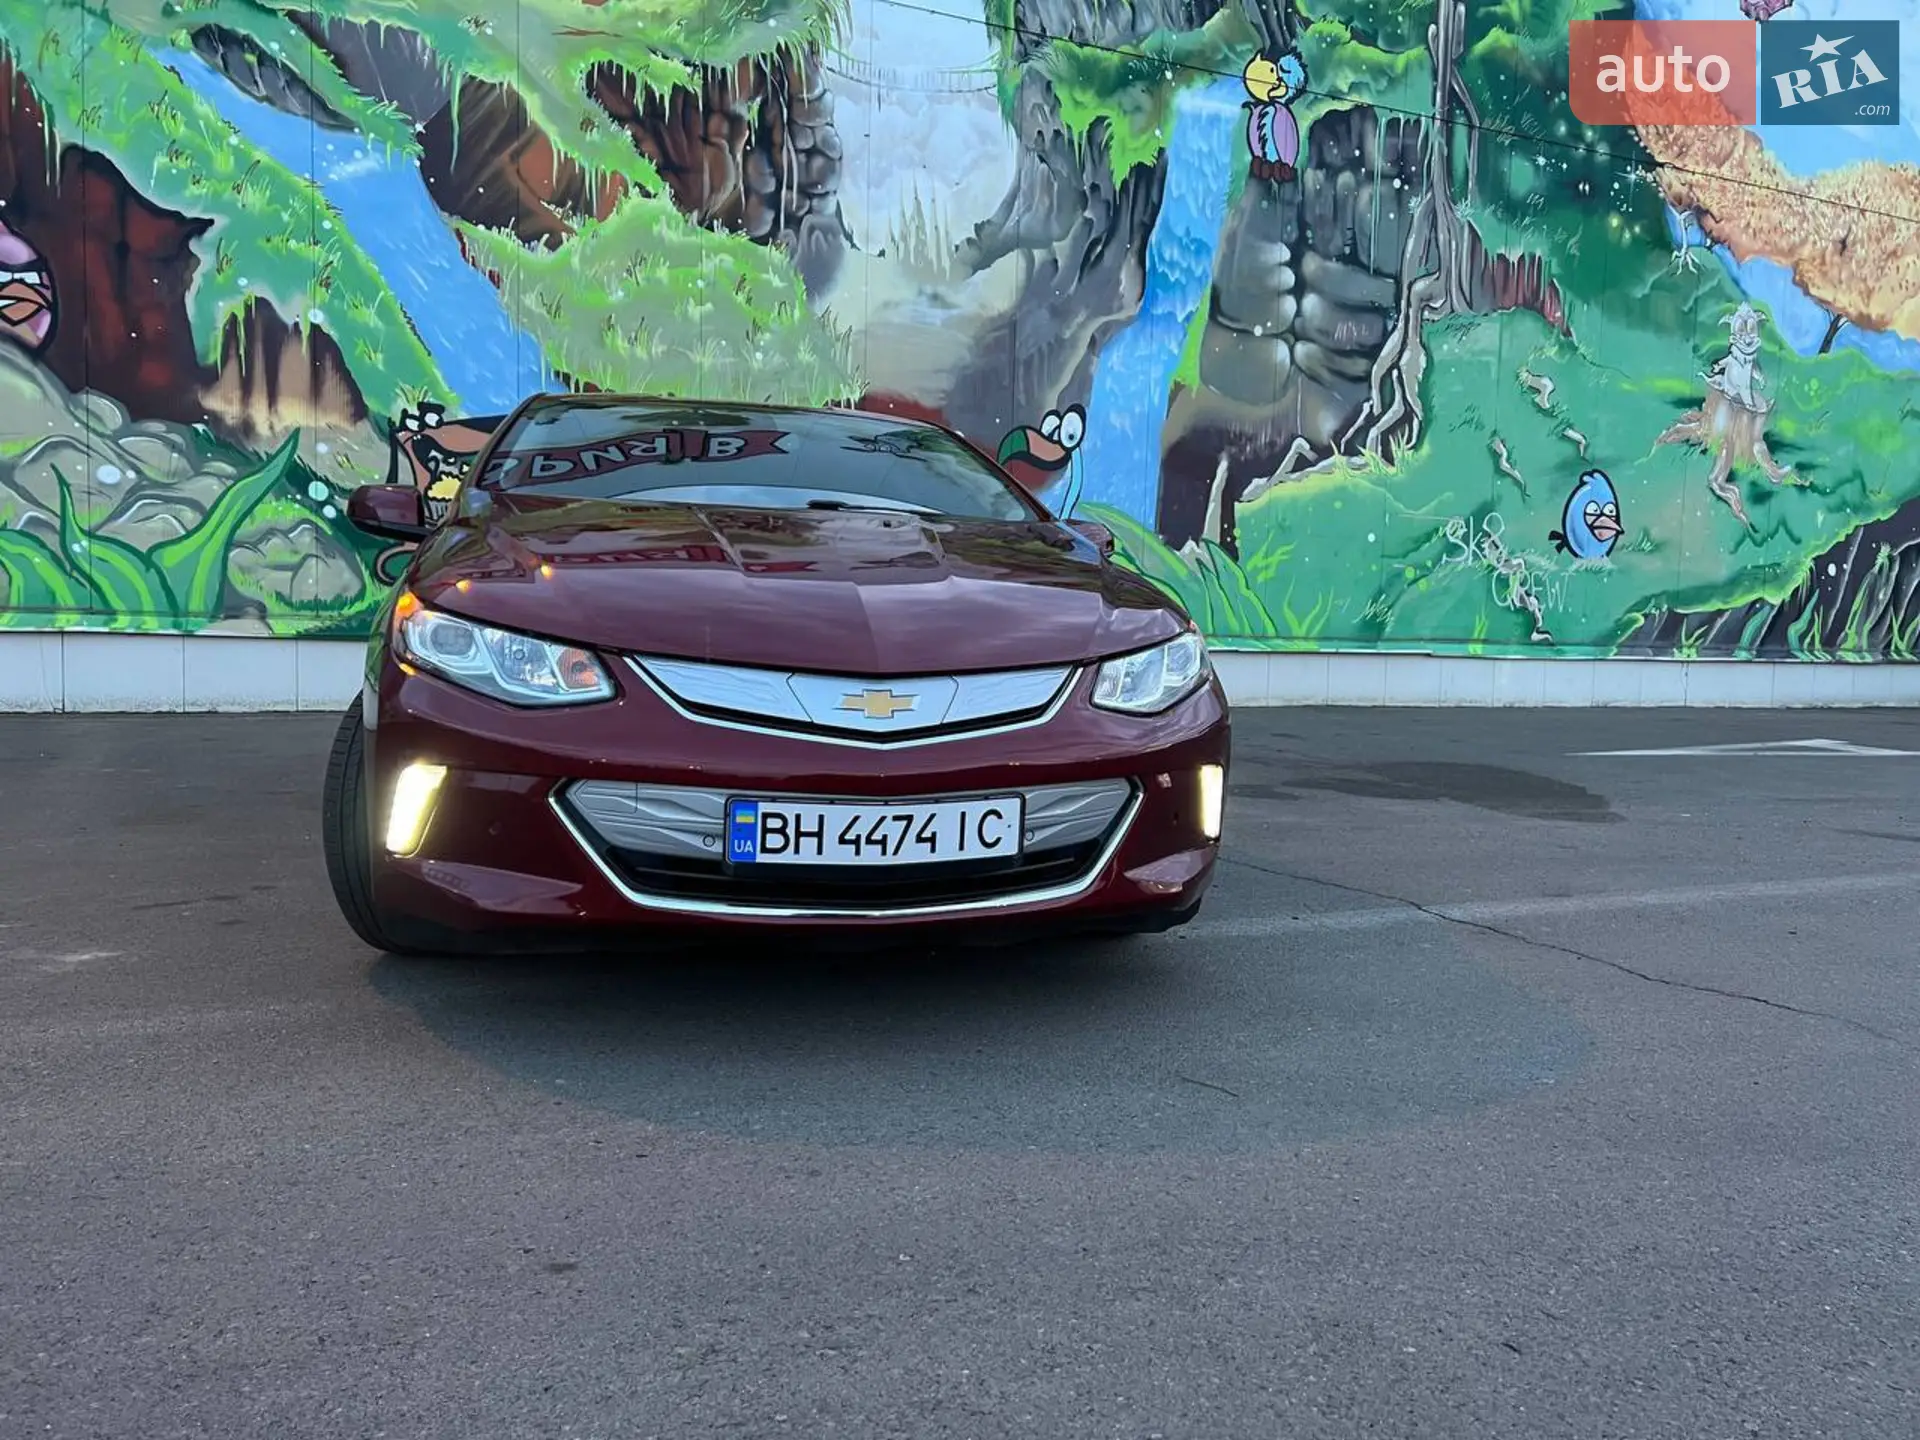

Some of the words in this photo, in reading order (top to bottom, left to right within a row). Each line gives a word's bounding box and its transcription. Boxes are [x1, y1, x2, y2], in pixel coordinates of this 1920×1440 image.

[734, 839, 754, 853] UA
[759, 811, 825, 855] BH
[838, 812, 937, 856] 4474
[958, 809, 1004, 851] IC
